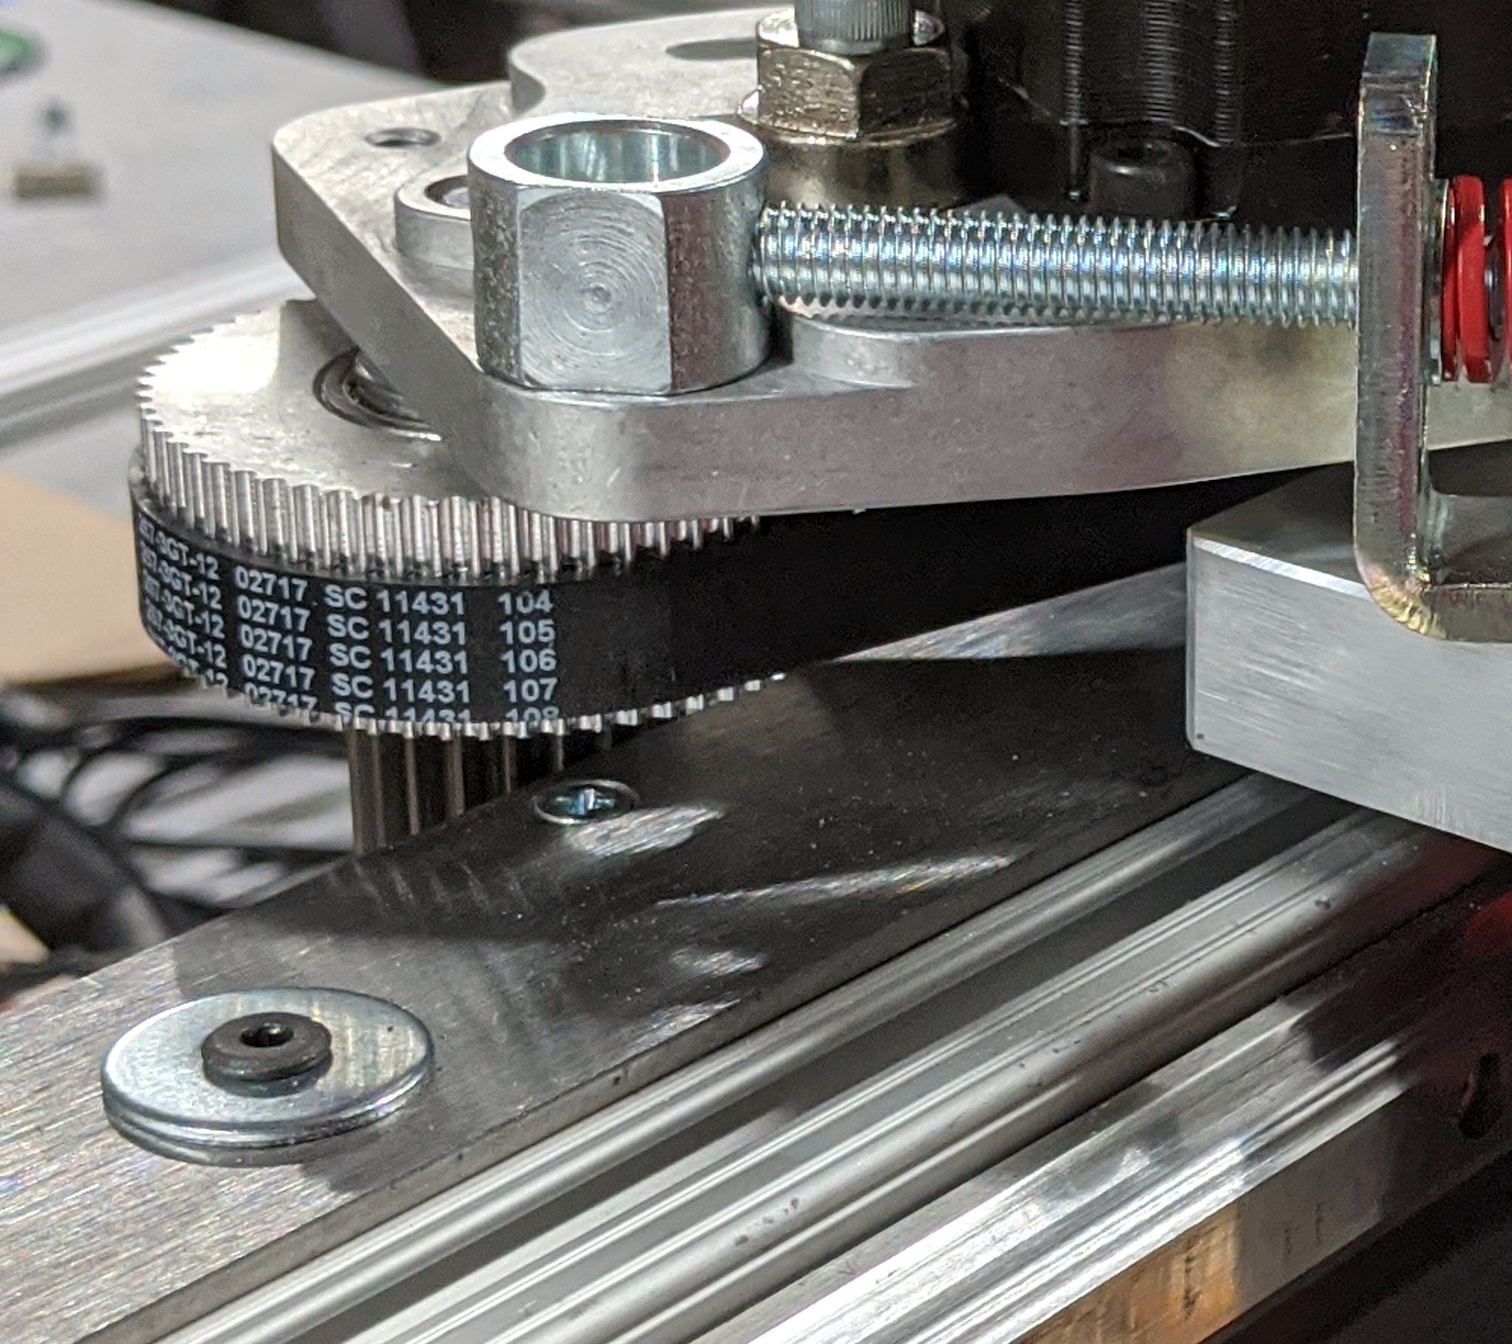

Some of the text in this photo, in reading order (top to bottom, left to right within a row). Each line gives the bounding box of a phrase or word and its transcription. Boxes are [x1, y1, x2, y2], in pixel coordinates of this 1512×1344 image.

[234, 565, 308, 602] 02717
[324, 584, 368, 610] SC
[376, 589, 465, 616] 11431
[498, 589, 554, 615] 104
[237, 595, 311, 632] 02717
[327, 614, 370, 640] SC
[378, 619, 467, 646] 11431
[500, 619, 556, 645] 105
[239, 624, 313, 661] 02717
[329, 643, 372, 670] SC
[380, 648, 468, 674] 11431
[501, 649, 557, 674] 106
[242, 653, 315, 691] 02717
[331, 673, 374, 699] SC
[382, 678, 470, 704] 11431
[503, 677, 558, 703] 107
